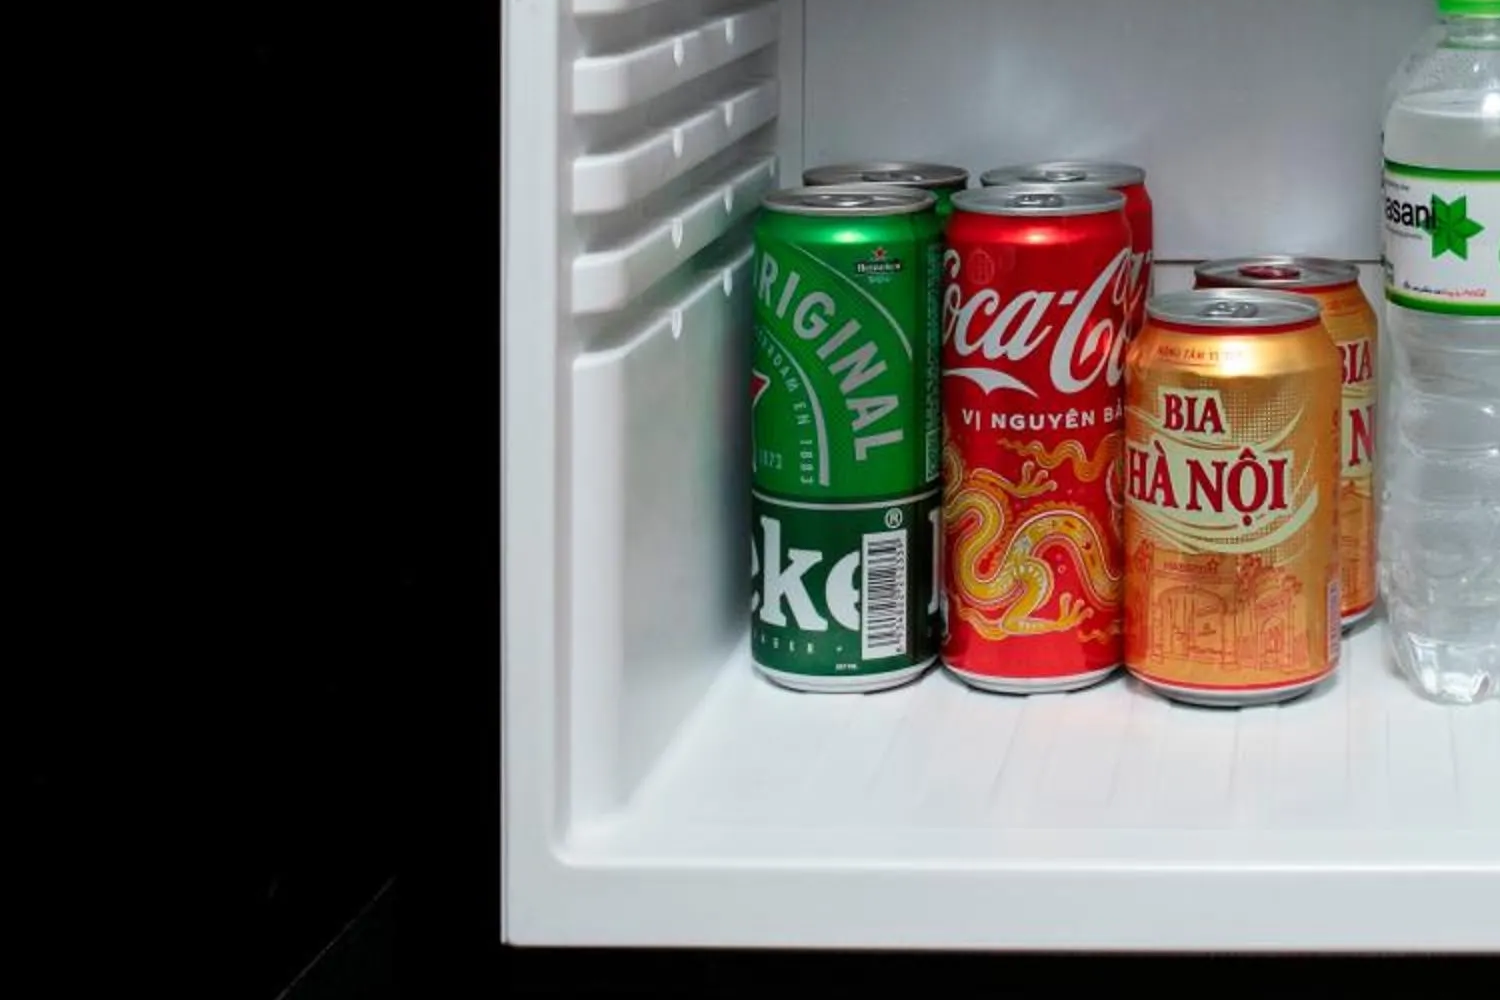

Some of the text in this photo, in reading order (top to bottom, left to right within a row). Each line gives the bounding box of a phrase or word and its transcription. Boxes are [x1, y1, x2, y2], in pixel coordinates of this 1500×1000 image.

[754, 250, 904, 462] RIGINAL
[962, 408, 981, 431] VỊ
[991, 408, 1095, 430] NGUYÊN
[1164, 394, 1225, 434] BIA
[1128, 440, 1289, 526] HÀ NỘI
